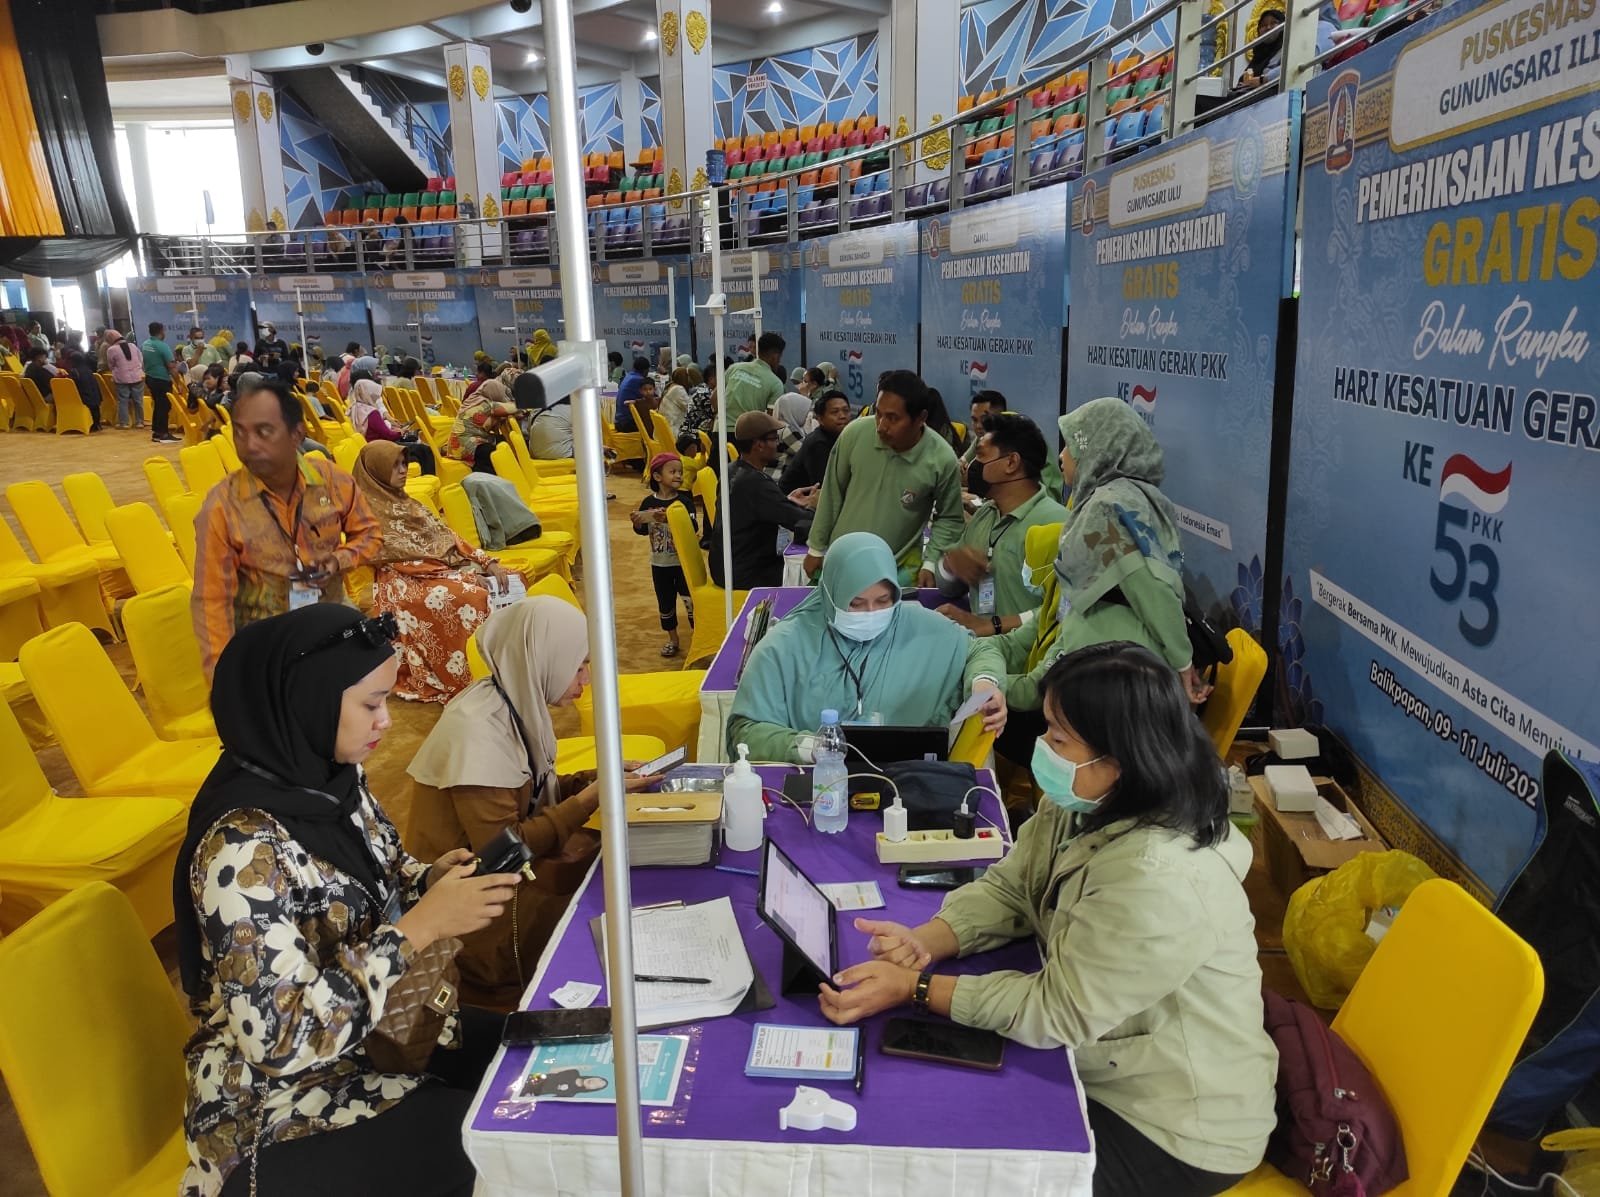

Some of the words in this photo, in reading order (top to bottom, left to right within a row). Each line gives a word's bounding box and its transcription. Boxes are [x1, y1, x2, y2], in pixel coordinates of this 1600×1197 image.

[1460, 0, 1596, 71] PUSKESMAS
[1439, 44, 1564, 116] GUNUNGSARI
[1132, 162, 1176, 193] PUSKESMAS
[1356, 130, 1531, 225] PEMERIKSAAN
[1127, 188, 1167, 213] GUNUNGSARI
[1167, 184, 1182, 202] ULU
[1096, 227, 1158, 265] PEMERIKSAAN
[1158, 211, 1226, 256] KESEHATAN
[1422, 196, 1600, 288] GRATIS
[859, 268, 893, 285] KESEHATAN
[941, 255, 986, 280] PEMERIKSAAN
[986, 250, 1031, 276] KESEHATAN
[1122, 260, 1180, 299] GRATIS
[961, 279, 1002, 304] GRATIS
[862, 332, 882, 344] GERAK
[884, 333, 897, 345] PKK
[937, 335, 952, 349] HARI
[953, 336, 987, 352] KESATUAN
[988, 338, 1016, 354] GERAK
[1016, 339, 1033, 356] PKK
[1413, 300, 1485, 361] Dalam
[1487, 293, 1590, 379] Rangka
[839, 349, 847, 361] KE
[960, 359, 969, 375] KE
[1087, 344, 1107, 366] HARI
[1109, 345, 1157, 373] KESATUAN
[1159, 349, 1198, 377] GERAK
[1200, 352, 1229, 381] PKK
[848, 363, 863, 399] 53
[1117, 381, 1129, 403] KE
[1333, 365, 1380, 408] HARI
[1382, 371, 1515, 435] KESATUAN
[1402, 439, 1434, 487] KE
[1471, 510, 1504, 543] PKK
[1429, 500, 1500, 648] 53
[1347, 601, 1378, 635] Bersama
[1400, 636, 1460, 691] Mewujudkan
[1461, 678, 1488, 708] Asta
[1489, 696, 1516, 728] Cita
[1370, 659, 1432, 731] Balikpapan,
[1433, 709, 1453, 741] 09
[1460, 728, 1478, 763] 11
[1479, 742, 1508, 783] Juli
